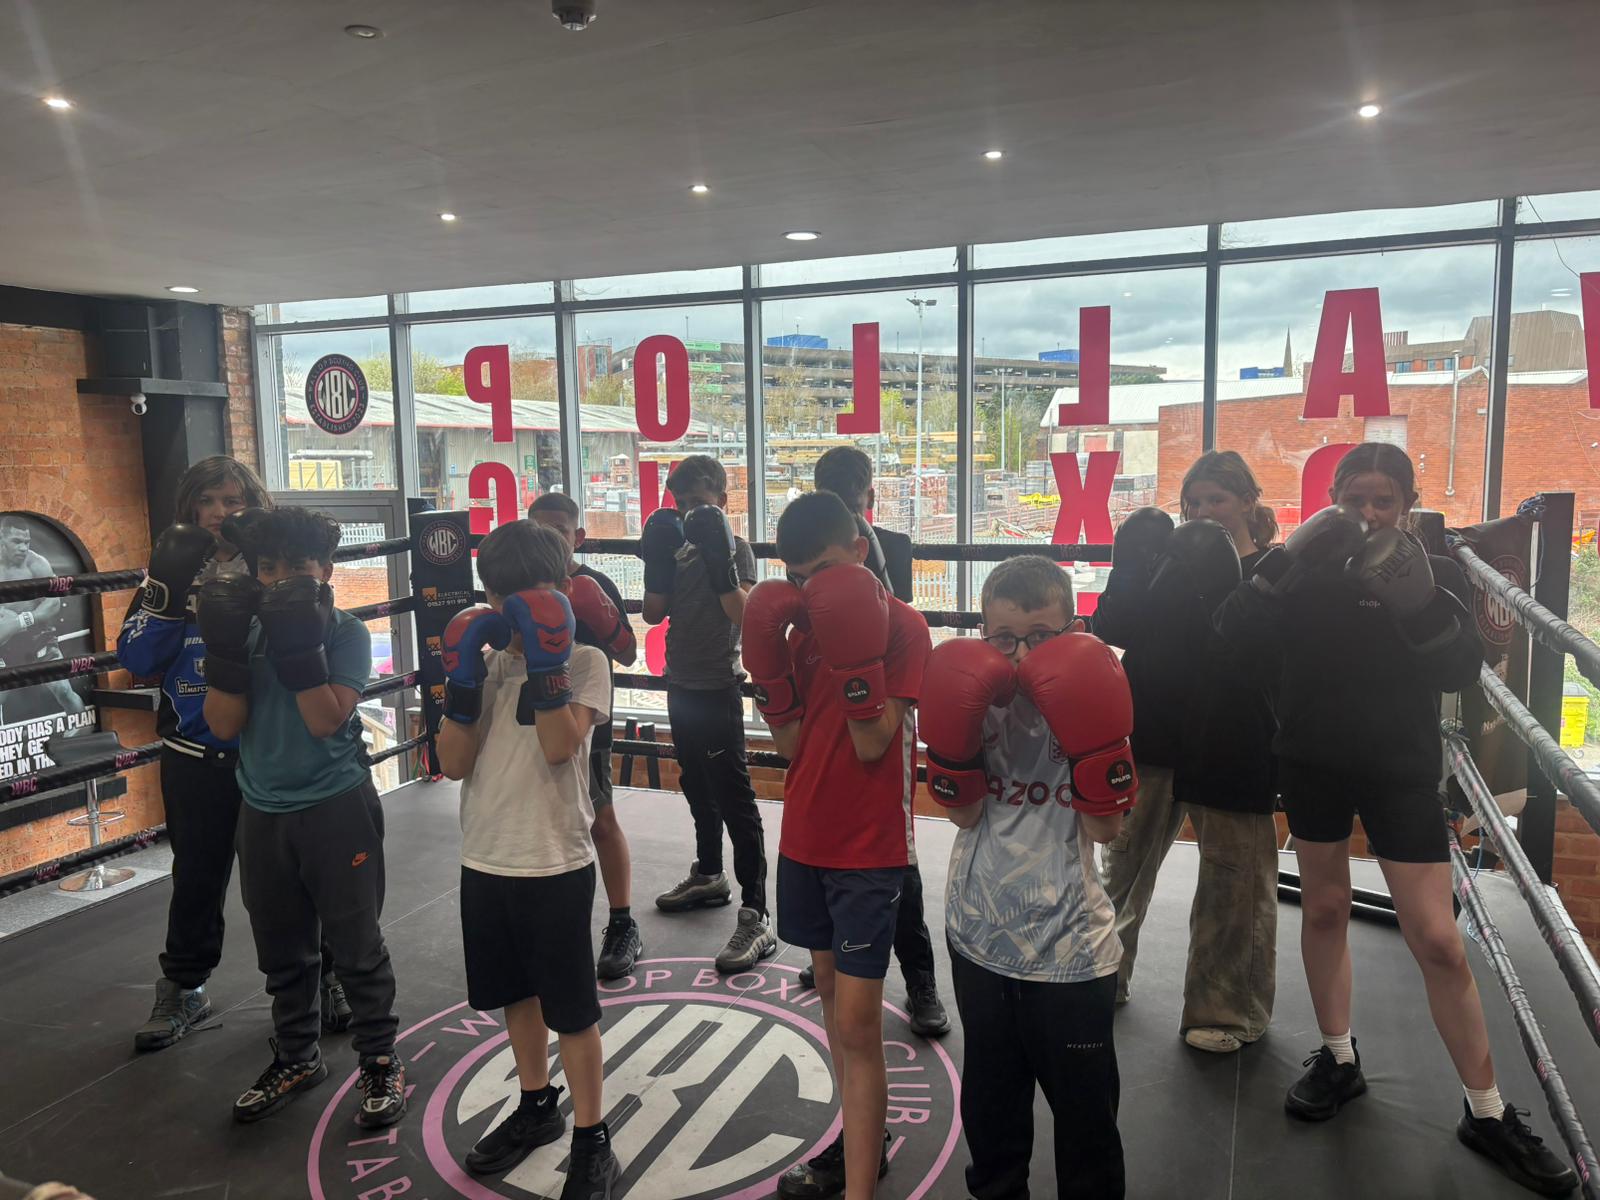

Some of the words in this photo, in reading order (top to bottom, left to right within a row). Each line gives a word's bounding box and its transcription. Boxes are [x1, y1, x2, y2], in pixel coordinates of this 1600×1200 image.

[429, 529, 457, 556] WBC
[28, 720, 53, 739] HAS
[56, 717, 66, 734] A
[67, 710, 96, 729] PLAN
[16, 757, 31, 775] IN
[883, 1040, 932, 1125] CLUB
